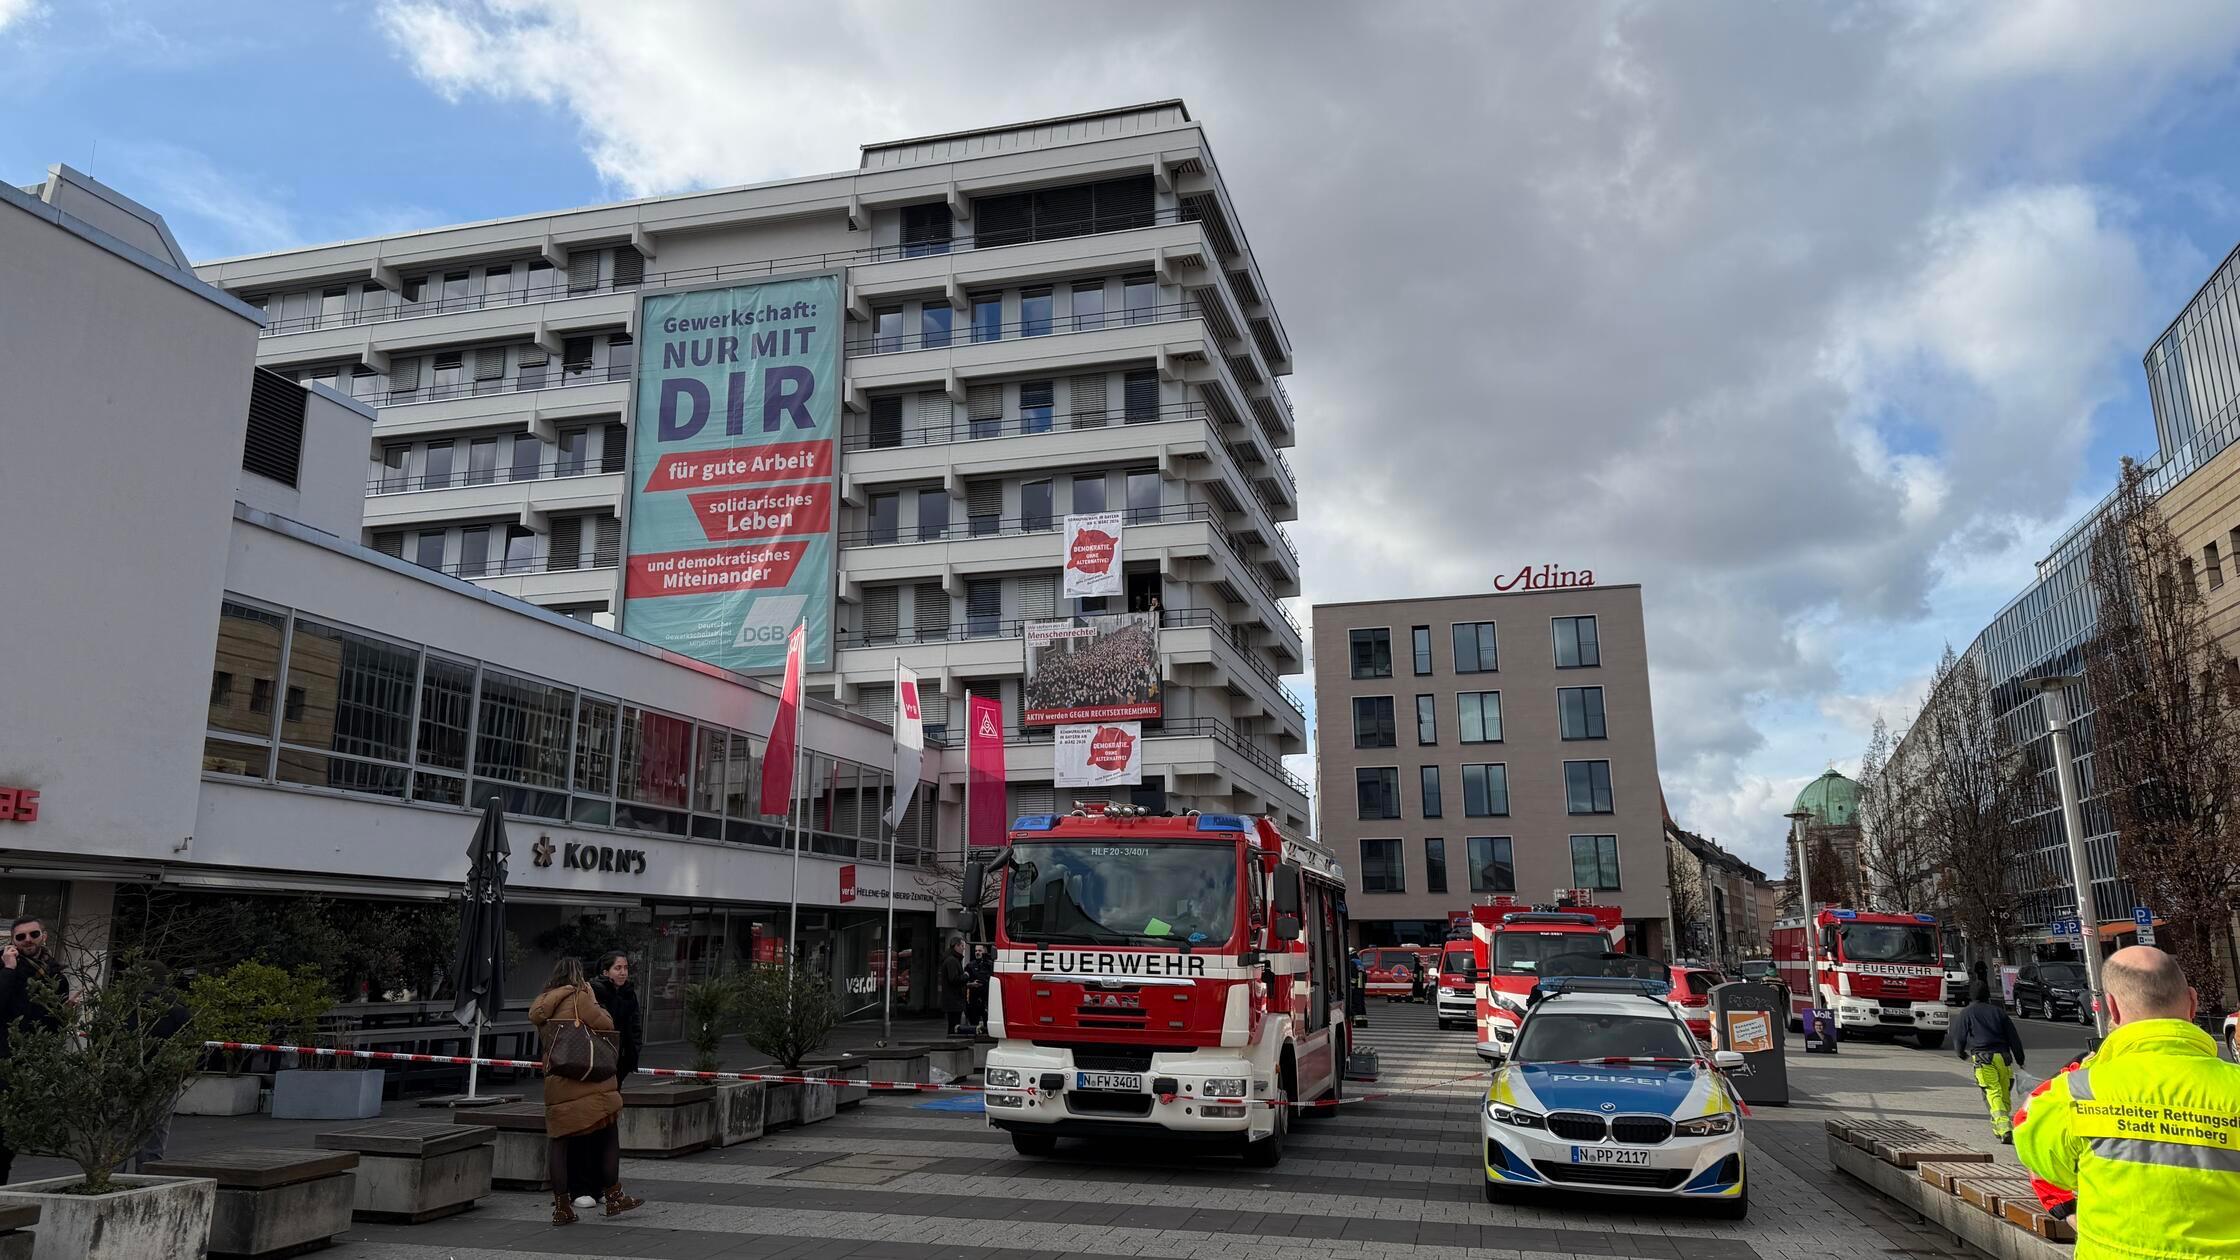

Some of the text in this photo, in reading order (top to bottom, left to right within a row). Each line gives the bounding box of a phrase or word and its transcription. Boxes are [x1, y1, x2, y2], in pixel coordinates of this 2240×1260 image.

[663, 301, 817, 334] Gewerkschaft:
[663, 326, 816, 369] NUR MIT
[657, 365, 817, 443] DIR
[668, 450, 815, 481] für gute Arbeit
[709, 493, 813, 514] solidarisches
[727, 510, 793, 532] Leben
[647, 548, 791, 572] und demokratisches
[663, 566, 772, 588] Miteinander
[1493, 563, 1596, 591] Adina
[743, 626, 785, 643] DGB
[1027, 628, 1097, 640] Menschenrechte!
[1026, 706, 1157, 721] AKTIV werden GEGEN RECHTSEXTREMISMUS
[563, 842, 647, 874] KORN'S
[2135, 909, 2146, 923] P
[1023, 951, 1205, 977] FEUERWEHR
[1855, 964, 1932, 975] FEUERWEHR
[845, 970, 877, 994] ver.di
[1083, 994, 1140, 1008] MAN
[1812, 1010, 1832, 1019] Volt
[1083, 1073, 1139, 1088] N FW 3401
[1553, 1075, 1661, 1086] POLIZEI
[2076, 1103, 2159, 1119] Einsatzleiter
[2117, 1119, 2228, 1144] Stadt Nürnberg
[1579, 1148, 1648, 1164] N PP 2117
